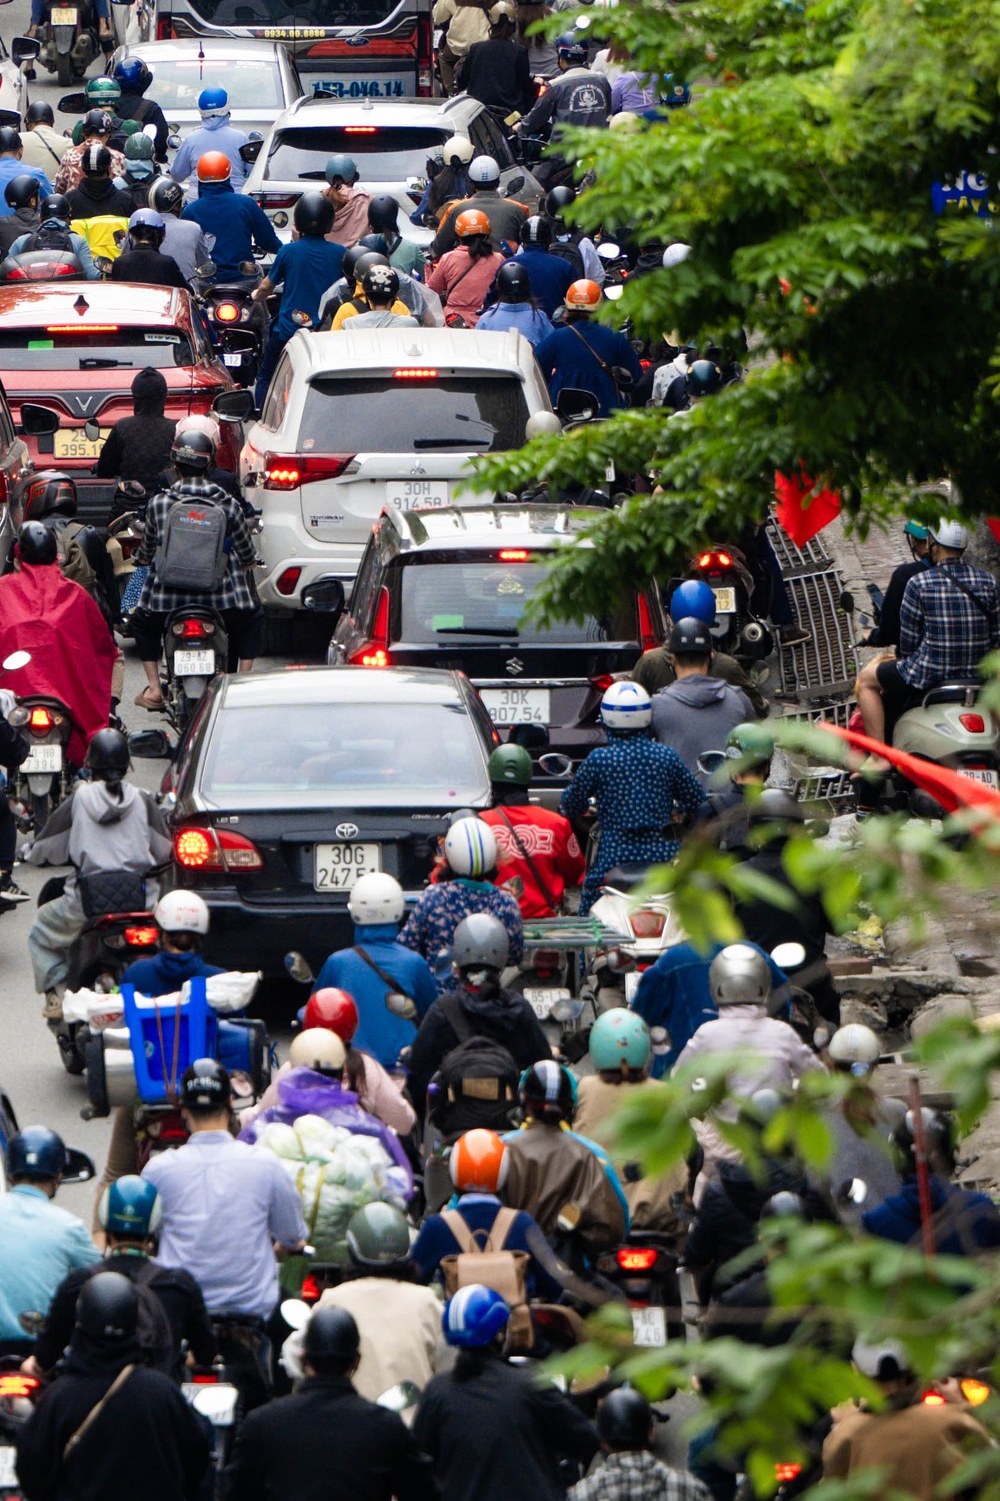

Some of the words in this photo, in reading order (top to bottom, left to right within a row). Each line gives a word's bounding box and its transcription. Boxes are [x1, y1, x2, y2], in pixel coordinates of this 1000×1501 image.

[264, 29, 326, 38] 0934.00.8886
[404, 482, 431, 496] 30H
[393, 496, 443, 511] 914.58
[177, 662, 211, 674] 060.68
[501, 689, 529, 705] 30K
[331, 846, 364, 865] 30G
